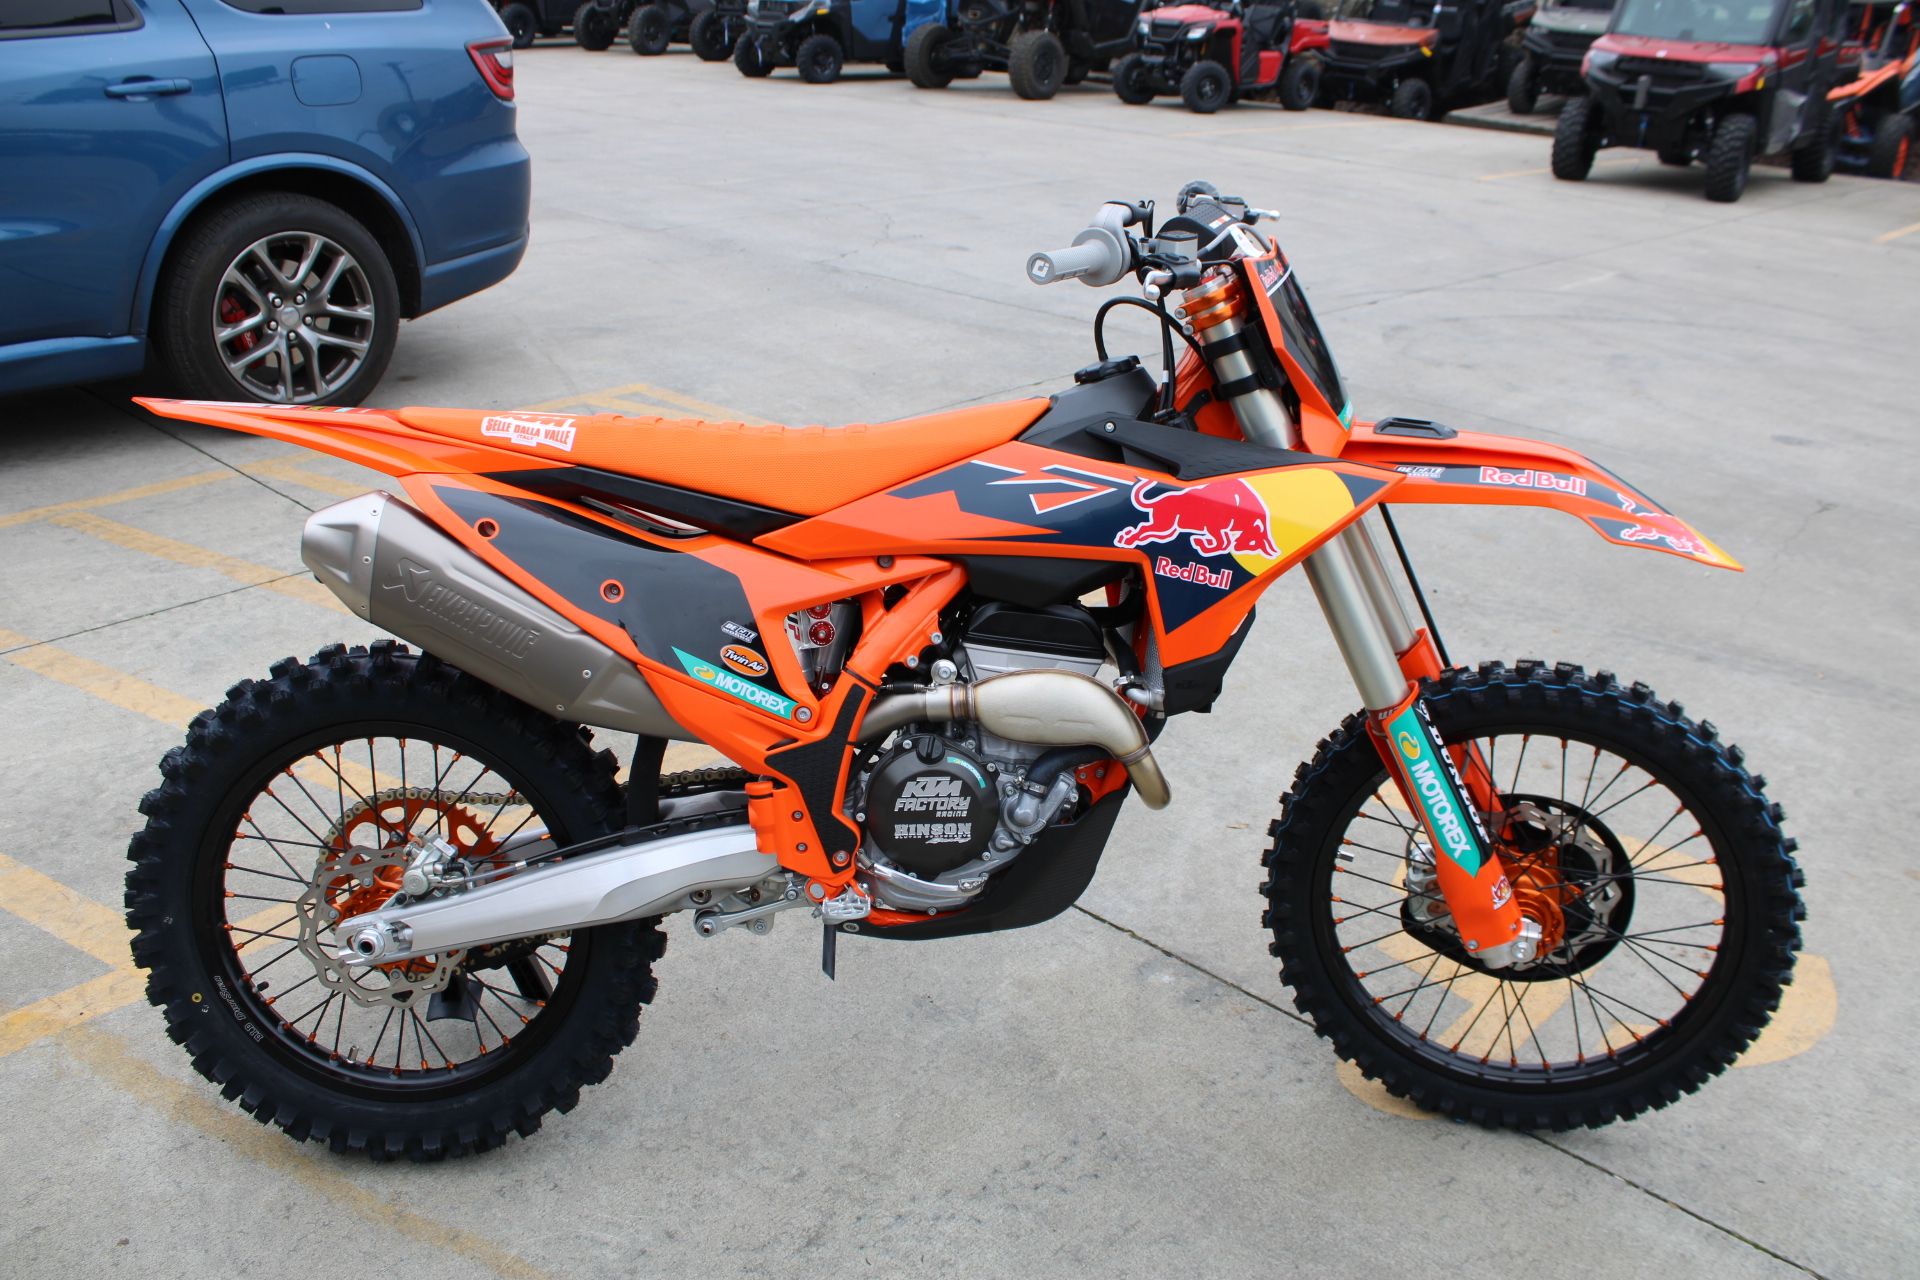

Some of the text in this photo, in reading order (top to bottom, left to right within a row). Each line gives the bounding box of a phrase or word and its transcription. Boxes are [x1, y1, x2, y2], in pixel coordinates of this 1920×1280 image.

[485, 418, 571, 445] SELLE DALLA VALLE
[1479, 466, 1587, 496] Red Bull
[1155, 556, 1233, 590] Red Bull
[724, 649, 766, 673] Twin Air
[714, 672, 789, 715] MOTOREX
[901, 776, 963, 798] KTM
[1427, 724, 1491, 844] DUNLOP
[894, 796, 971, 812] FACTORY
[935, 810, 968, 818] RACING
[1411, 759, 1472, 859] MOTOREX
[894, 822, 972, 836] HINSON
